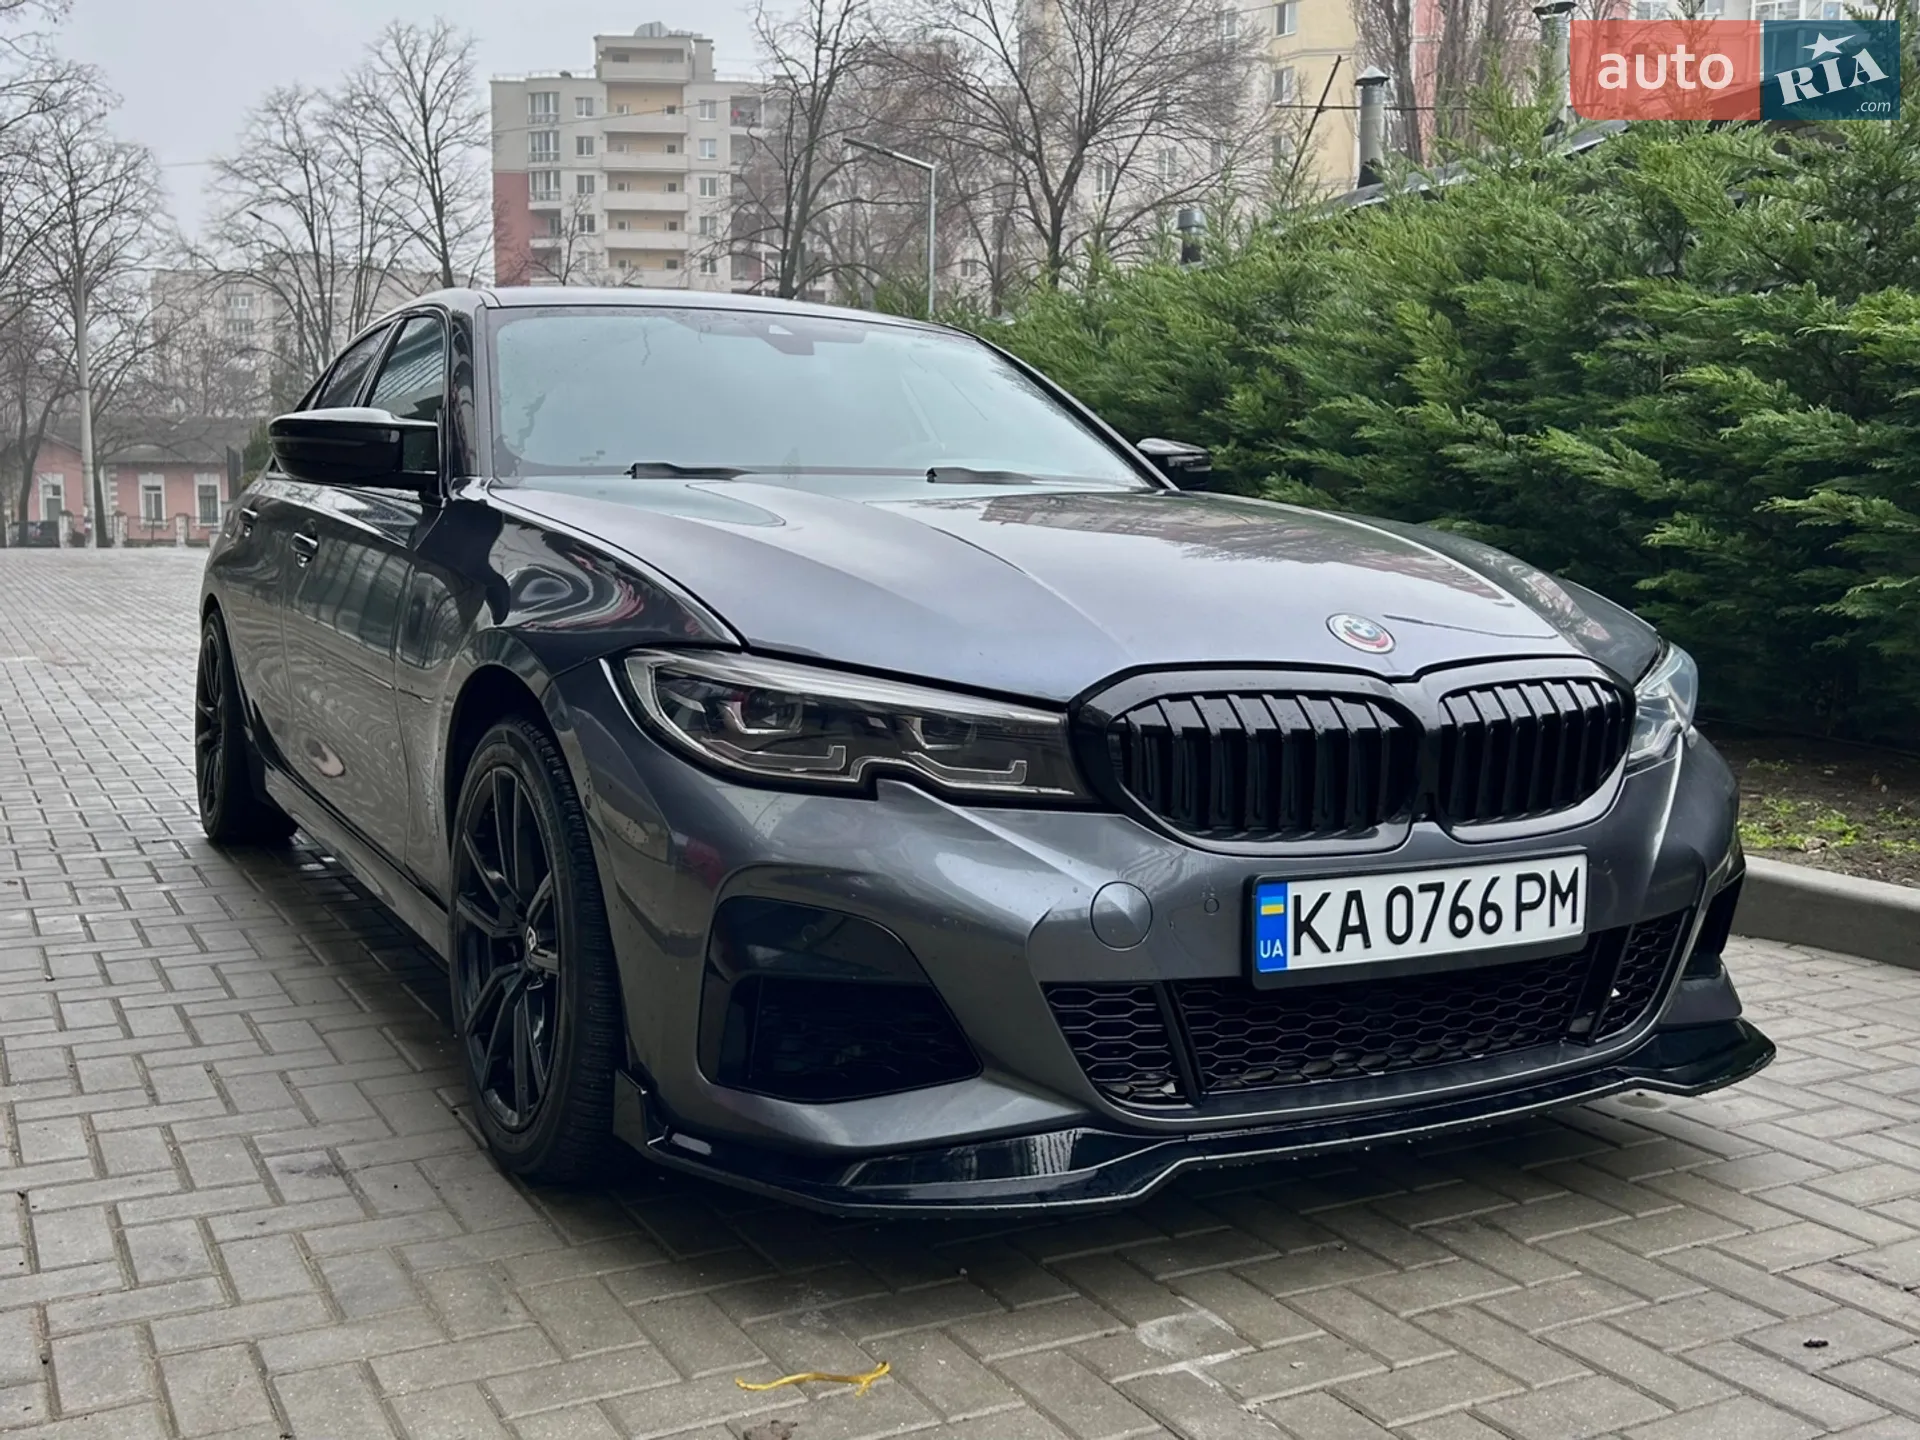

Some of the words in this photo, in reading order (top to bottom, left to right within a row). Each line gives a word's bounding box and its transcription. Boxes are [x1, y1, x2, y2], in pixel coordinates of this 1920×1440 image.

[1293, 889, 1372, 956] KA
[1386, 876, 1502, 945] 0766
[1515, 867, 1579, 932] PM
[1260, 939, 1284, 958] UA
